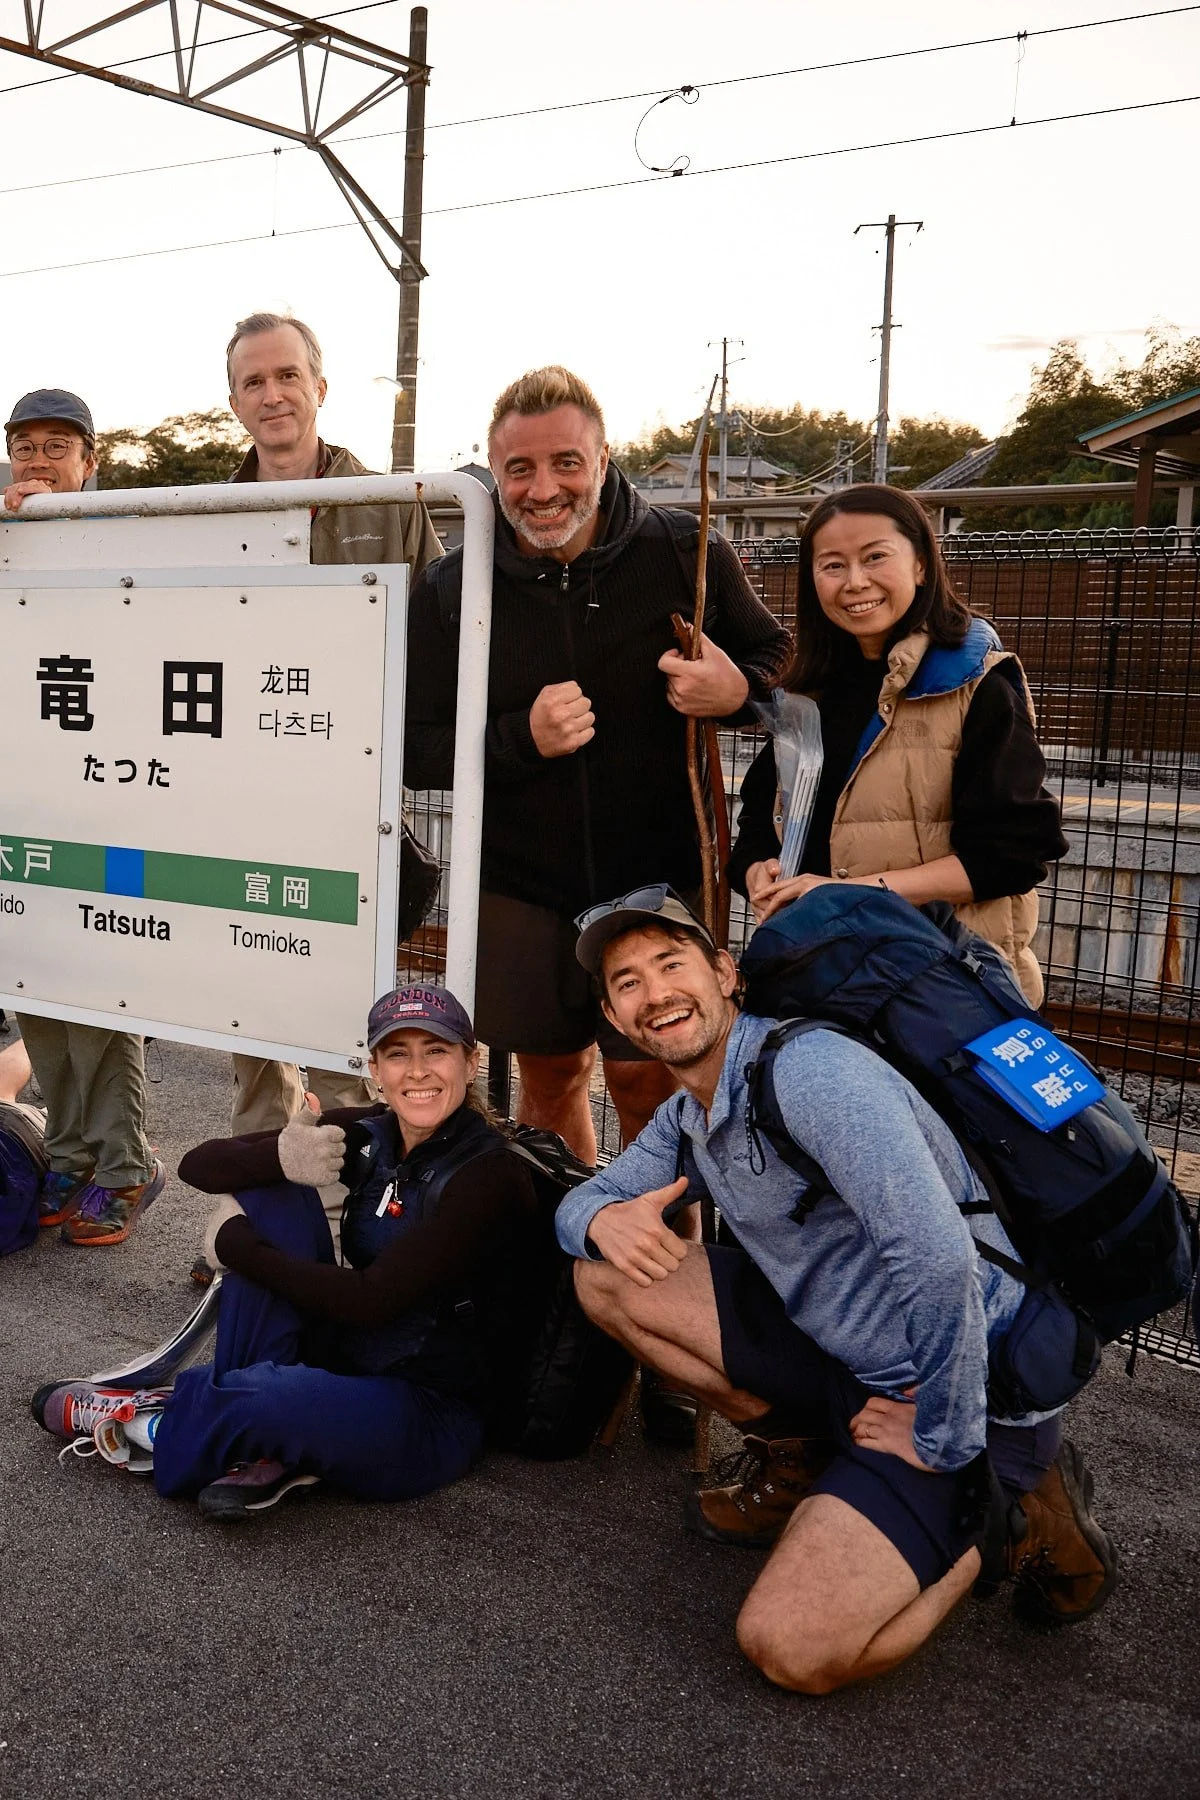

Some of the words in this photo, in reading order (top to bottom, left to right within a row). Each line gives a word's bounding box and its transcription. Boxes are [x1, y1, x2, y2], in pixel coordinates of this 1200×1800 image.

[36, 654, 223, 739] 竜田
[261, 665, 310, 696] 龙田
[258, 709, 334, 741] 다츠타
[84, 754, 171, 788] たつた
[244, 871, 310, 910] 富岡
[78, 903, 171, 942] Tatsuta
[229, 924, 311, 957] Tomioka
[378, 986, 448, 1017] LONDON
[991, 1036, 1072, 1108] 報道
[1016, 1028, 1088, 1092] PRESS
